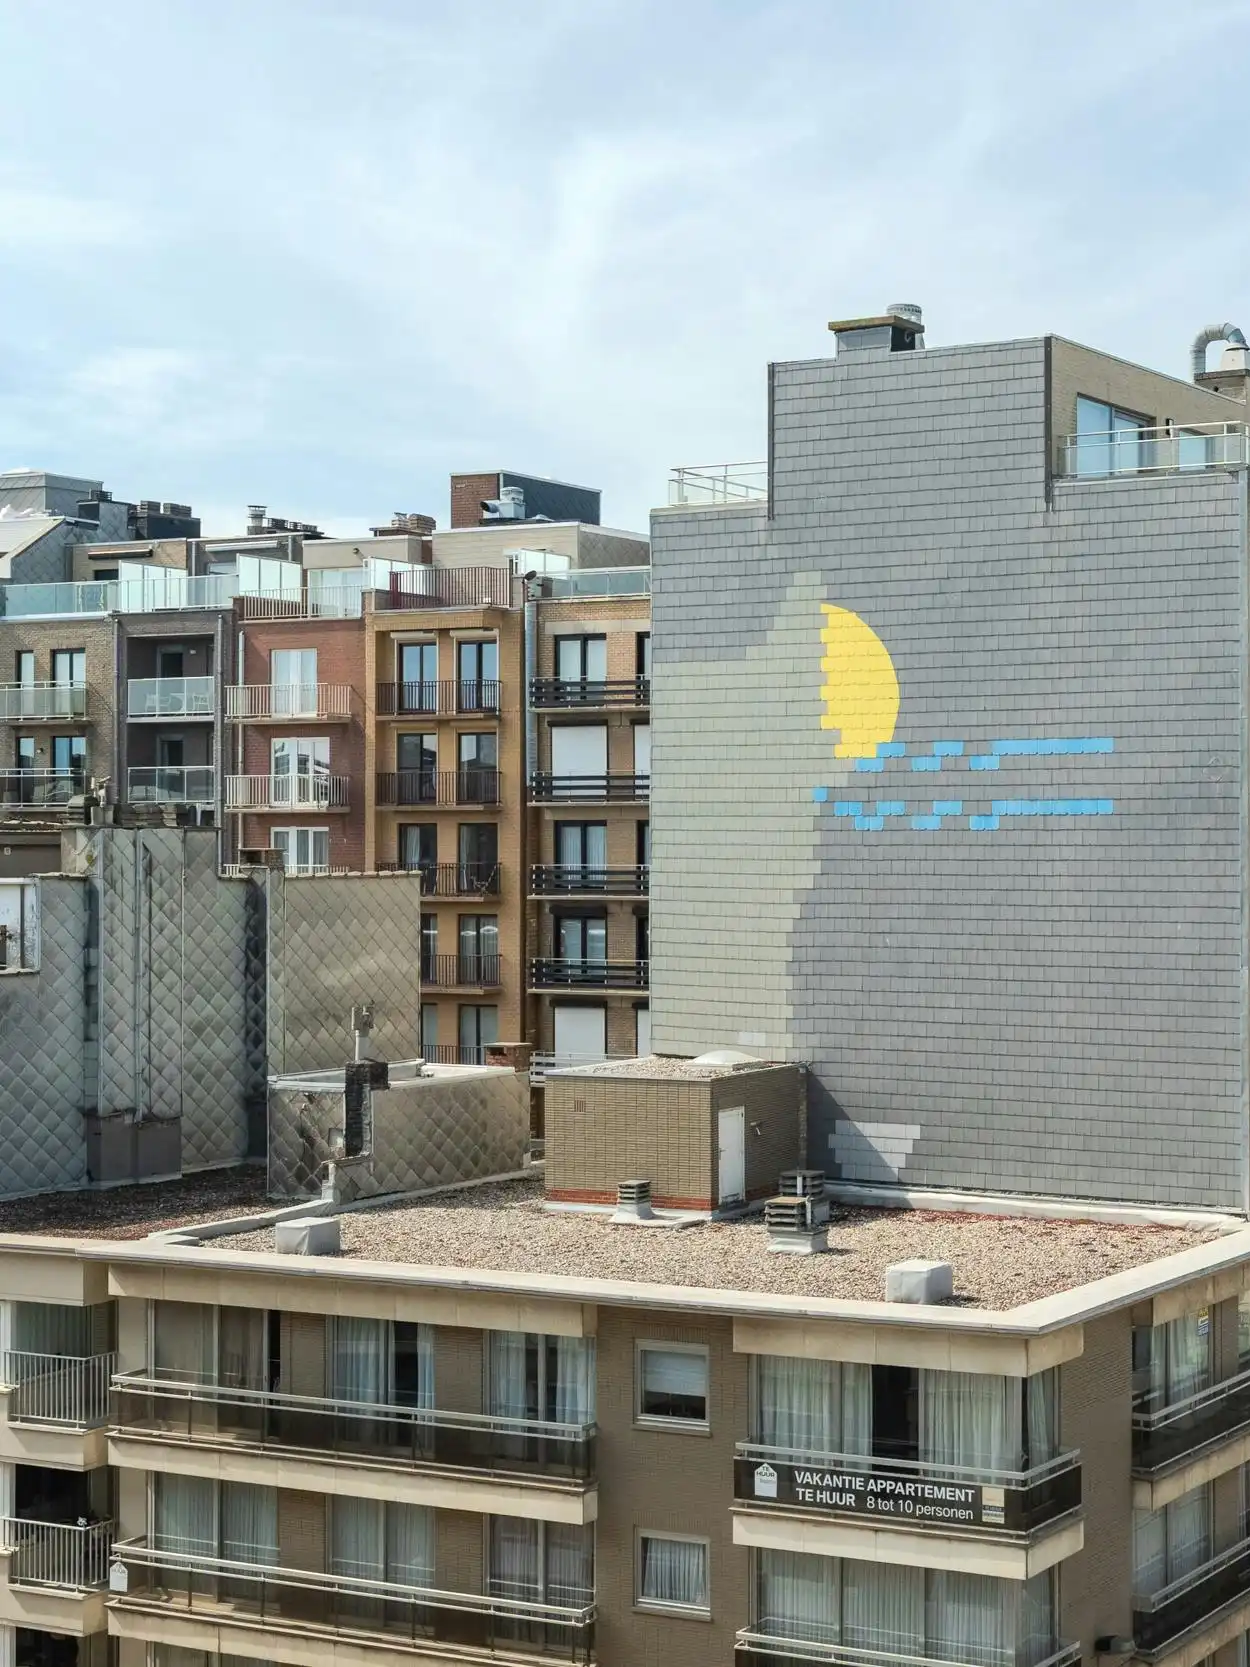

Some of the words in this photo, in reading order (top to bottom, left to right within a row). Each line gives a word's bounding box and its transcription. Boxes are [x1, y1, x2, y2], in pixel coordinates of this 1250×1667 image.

[756, 1470, 776, 1478] HUUR
[794, 1470, 865, 1491] VAKANTIE
[866, 1479, 976, 1503] APPARTEMENT
[795, 1487, 814, 1502] TE
[816, 1489, 856, 1507] HUUR
[866, 1495, 876, 1509] 8
[878, 1497, 895, 1512] tot
[898, 1499, 914, 1514] 10
[916, 1504, 974, 1520] personen
